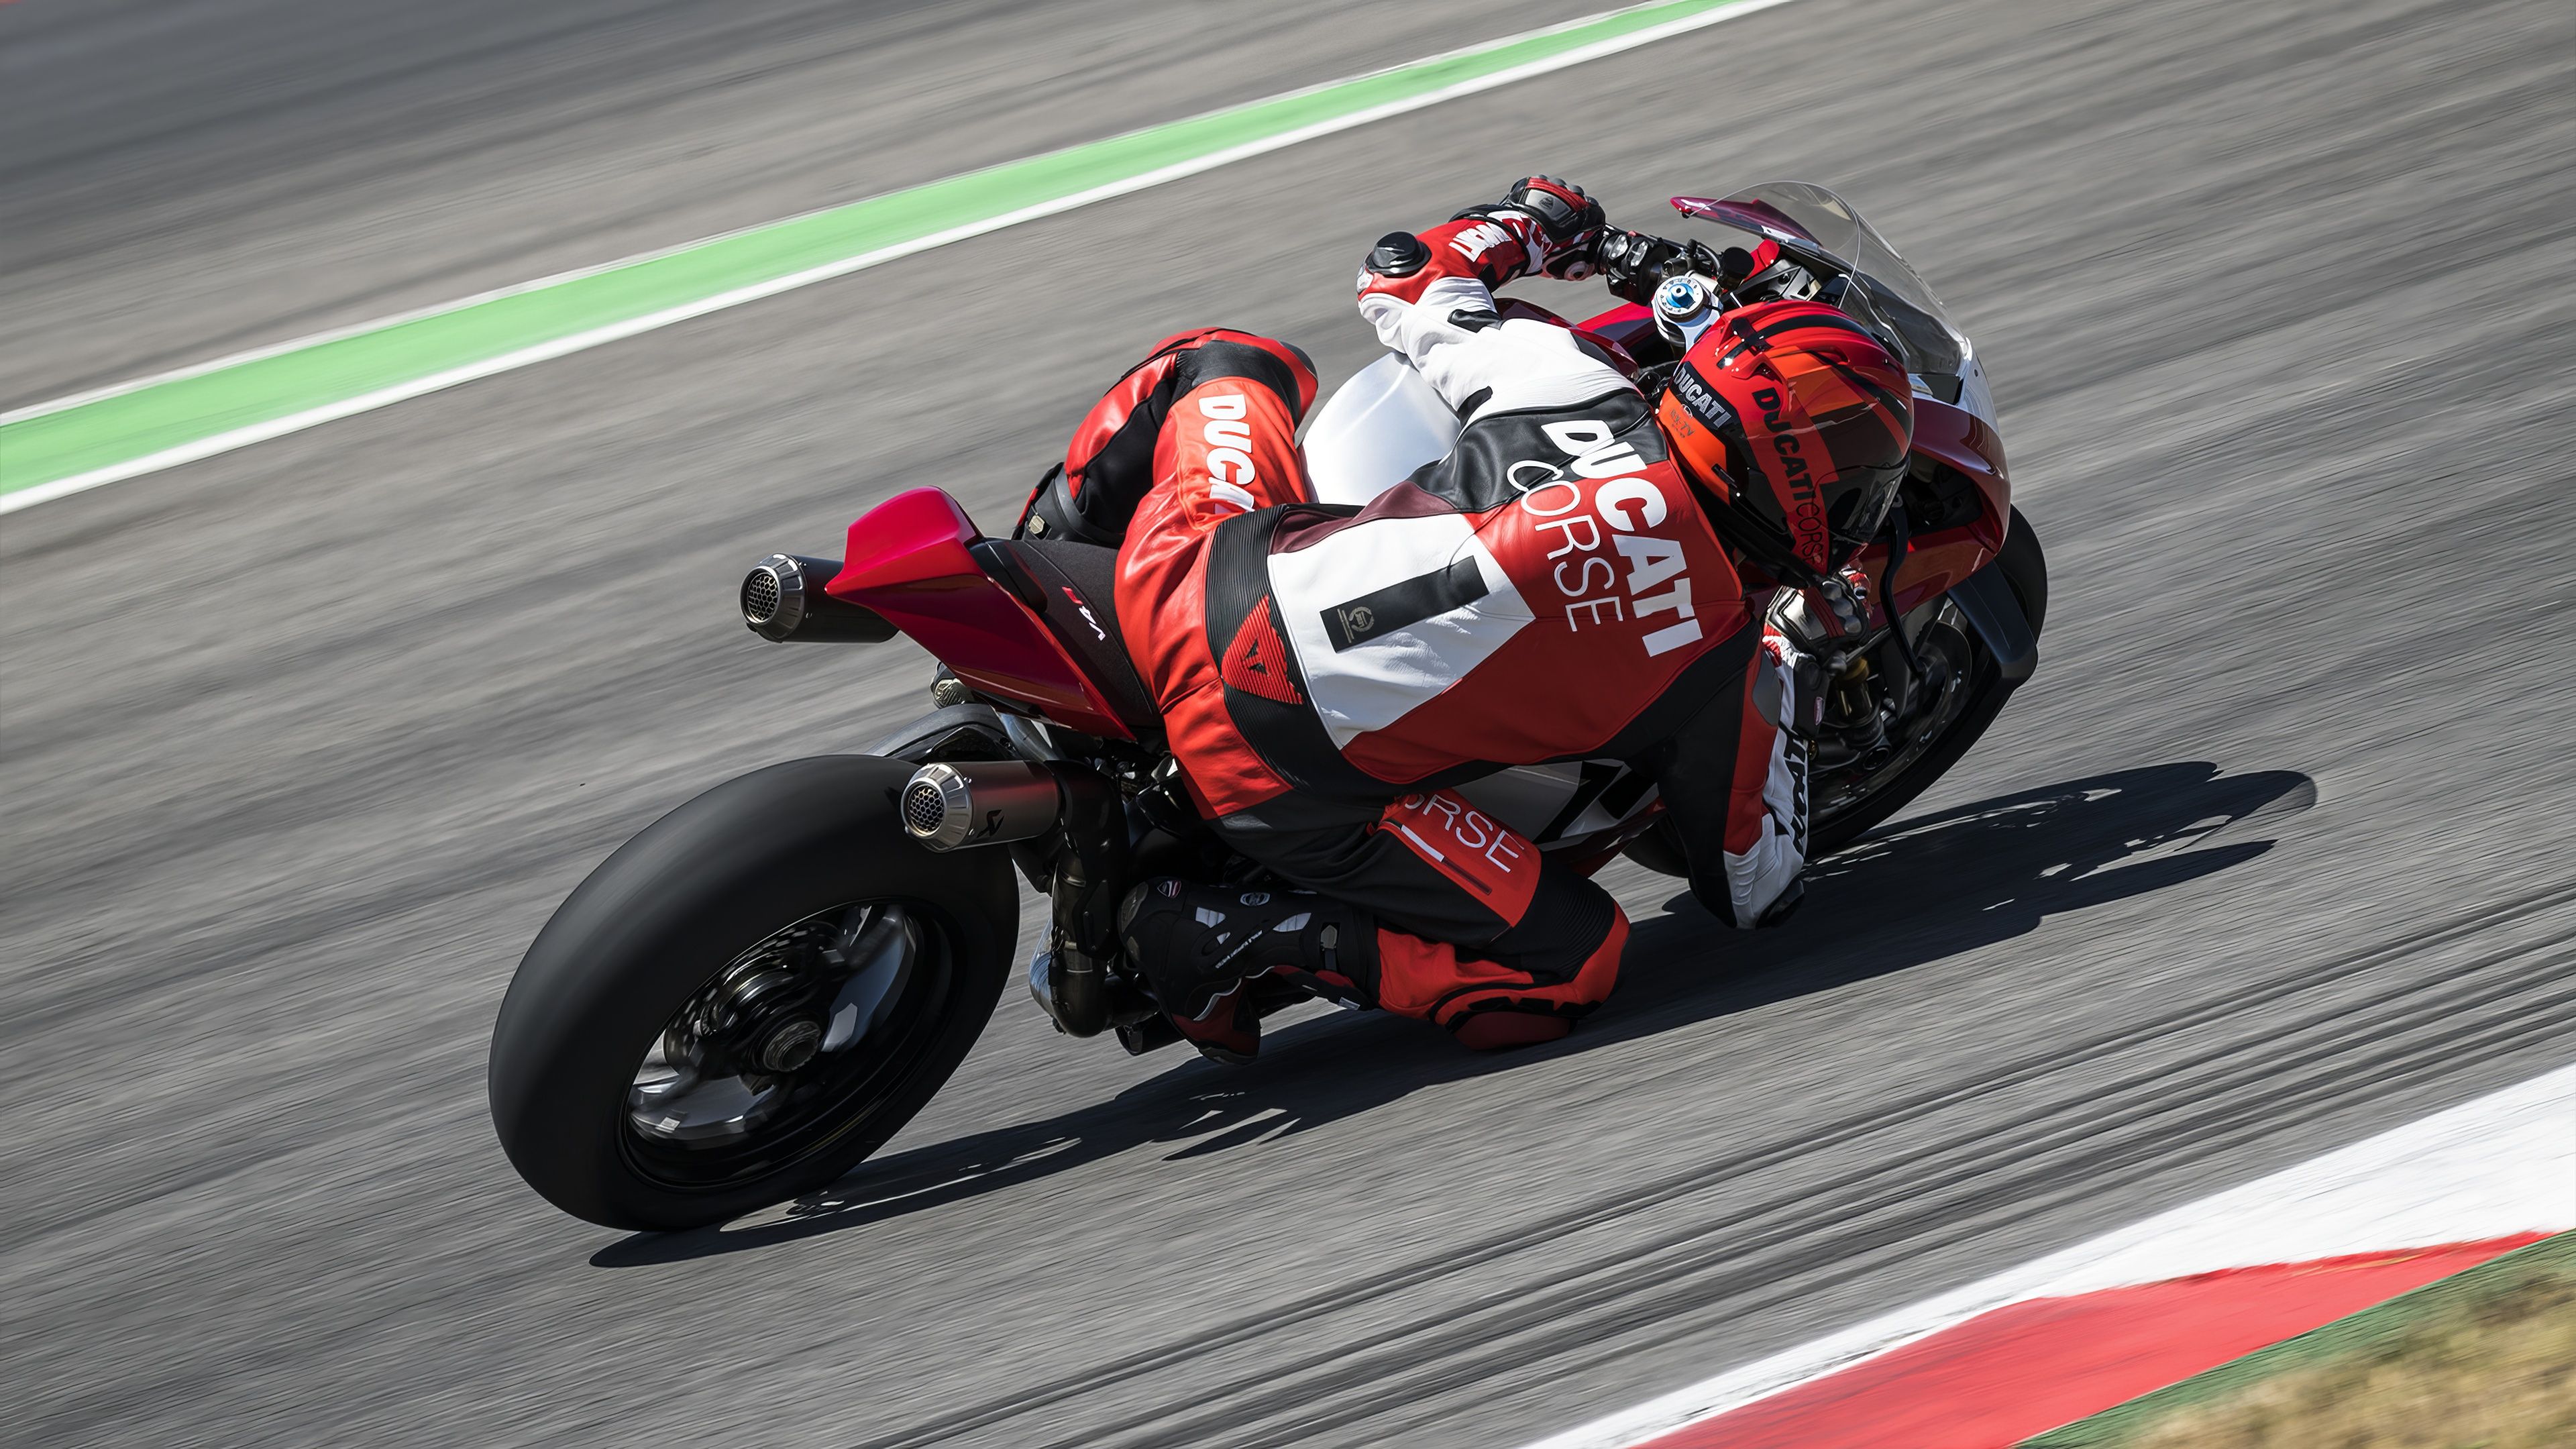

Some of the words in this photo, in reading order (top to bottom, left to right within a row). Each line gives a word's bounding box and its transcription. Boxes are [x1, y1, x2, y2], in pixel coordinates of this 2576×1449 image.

[1674, 367, 1731, 428] DUCATI
[1752, 386, 1817, 502] DUCATI
[1507, 460, 1623, 632] CORSE
[1541, 419, 1703, 657] DUCATI
